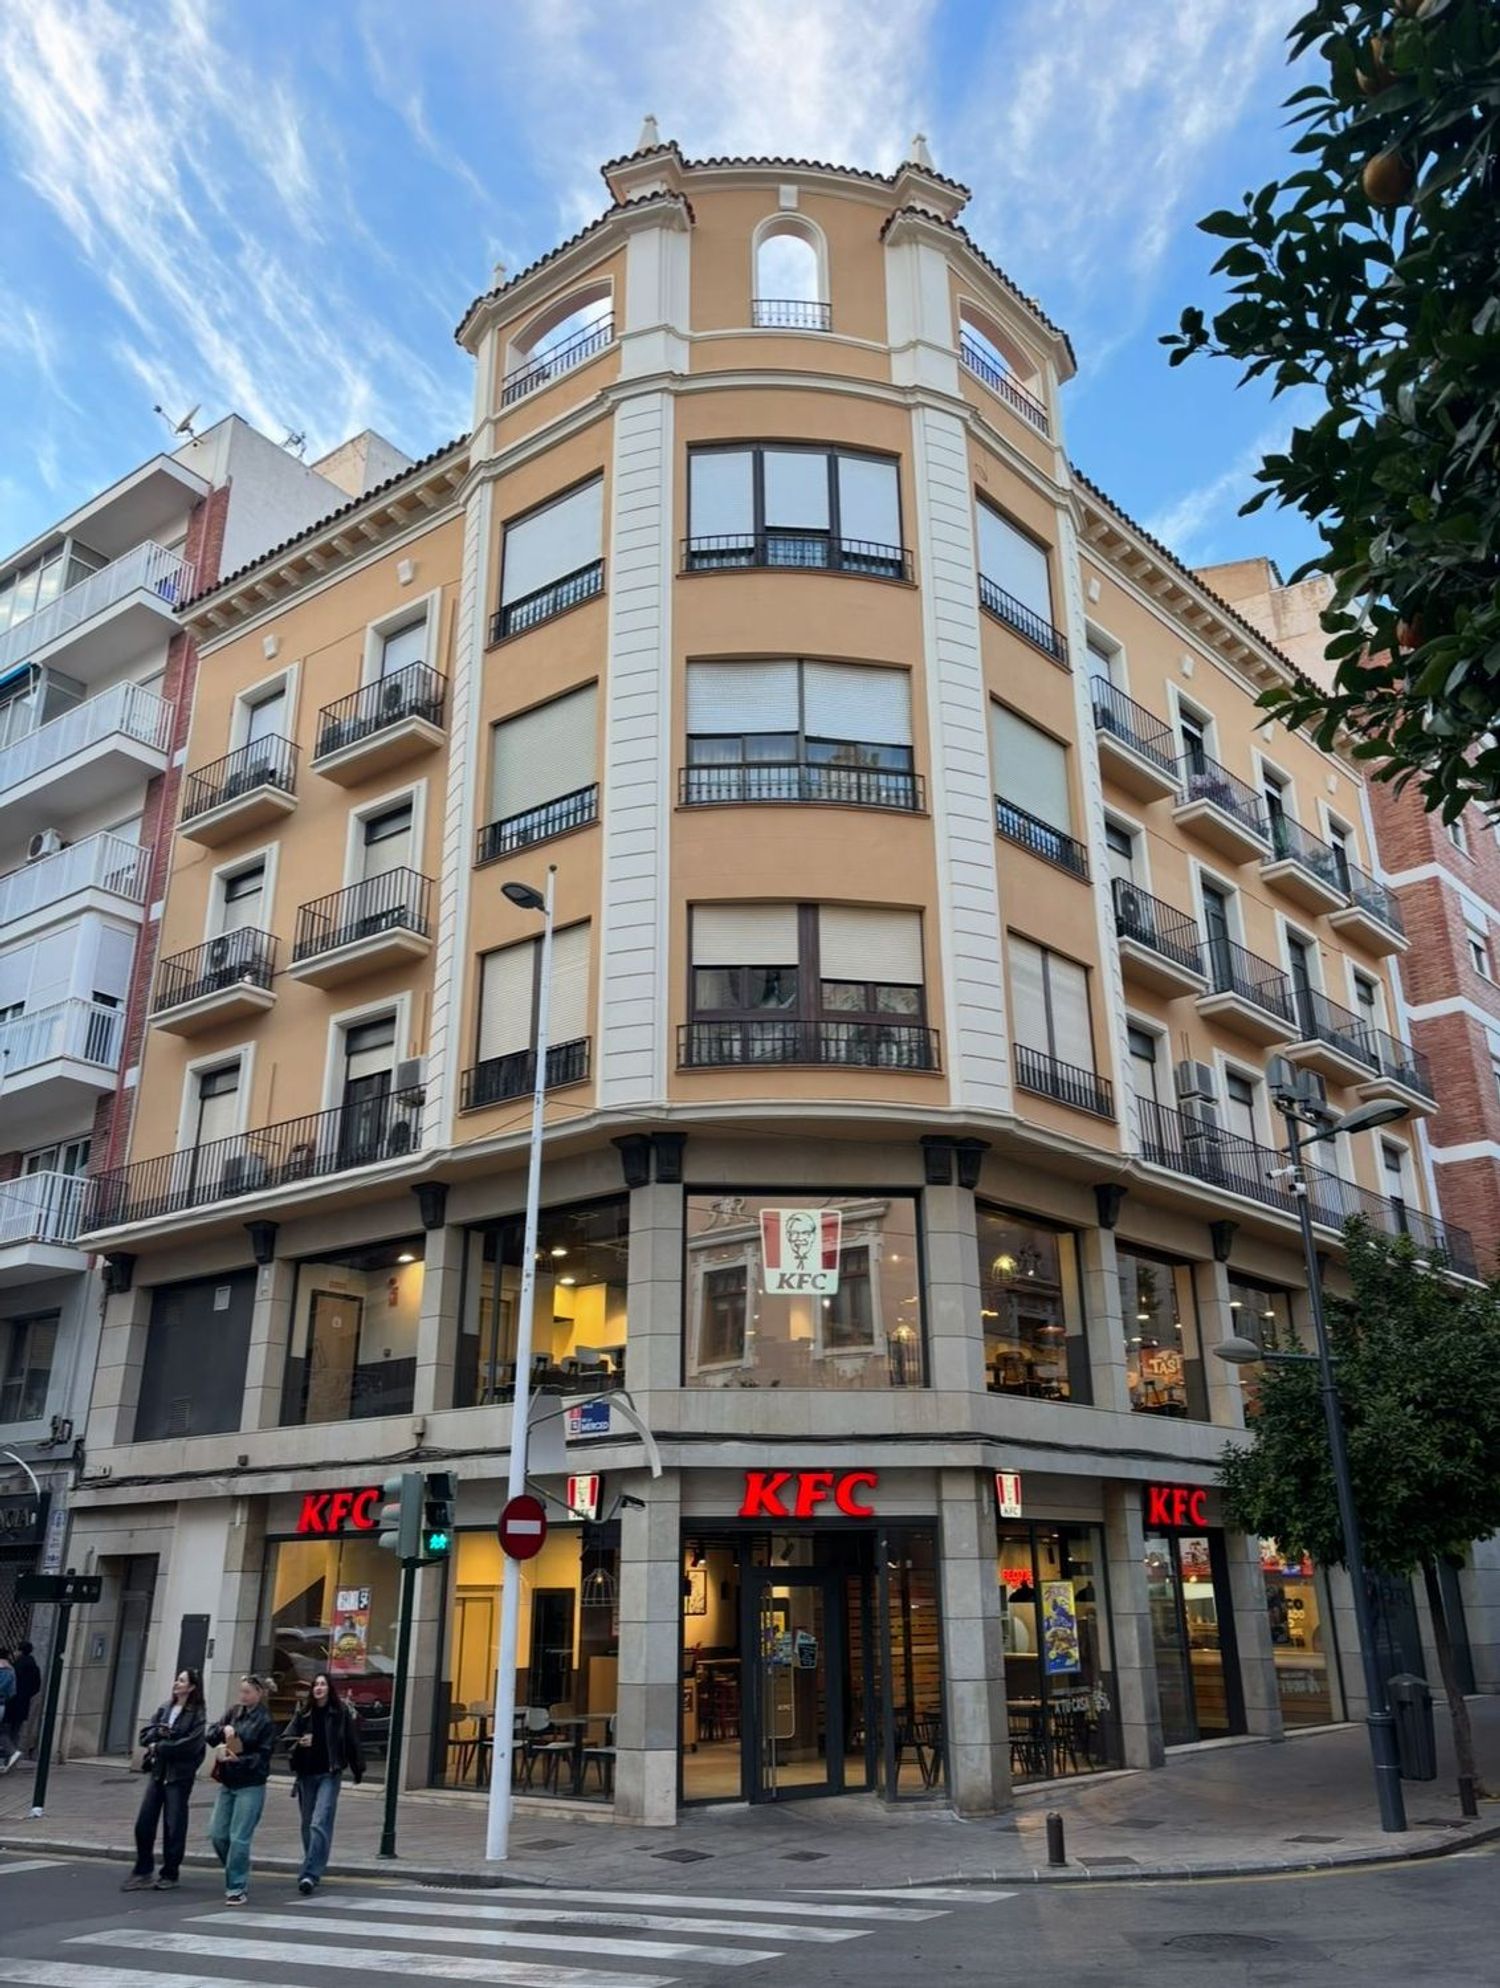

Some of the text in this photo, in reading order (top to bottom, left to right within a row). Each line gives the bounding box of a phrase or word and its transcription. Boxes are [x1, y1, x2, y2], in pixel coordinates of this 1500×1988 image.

[776, 1273, 827, 1290] KFC
[297, 1487, 380, 1534] KFC
[739, 1471, 879, 1518] KFC
[1149, 1486, 1208, 1527] KFC
